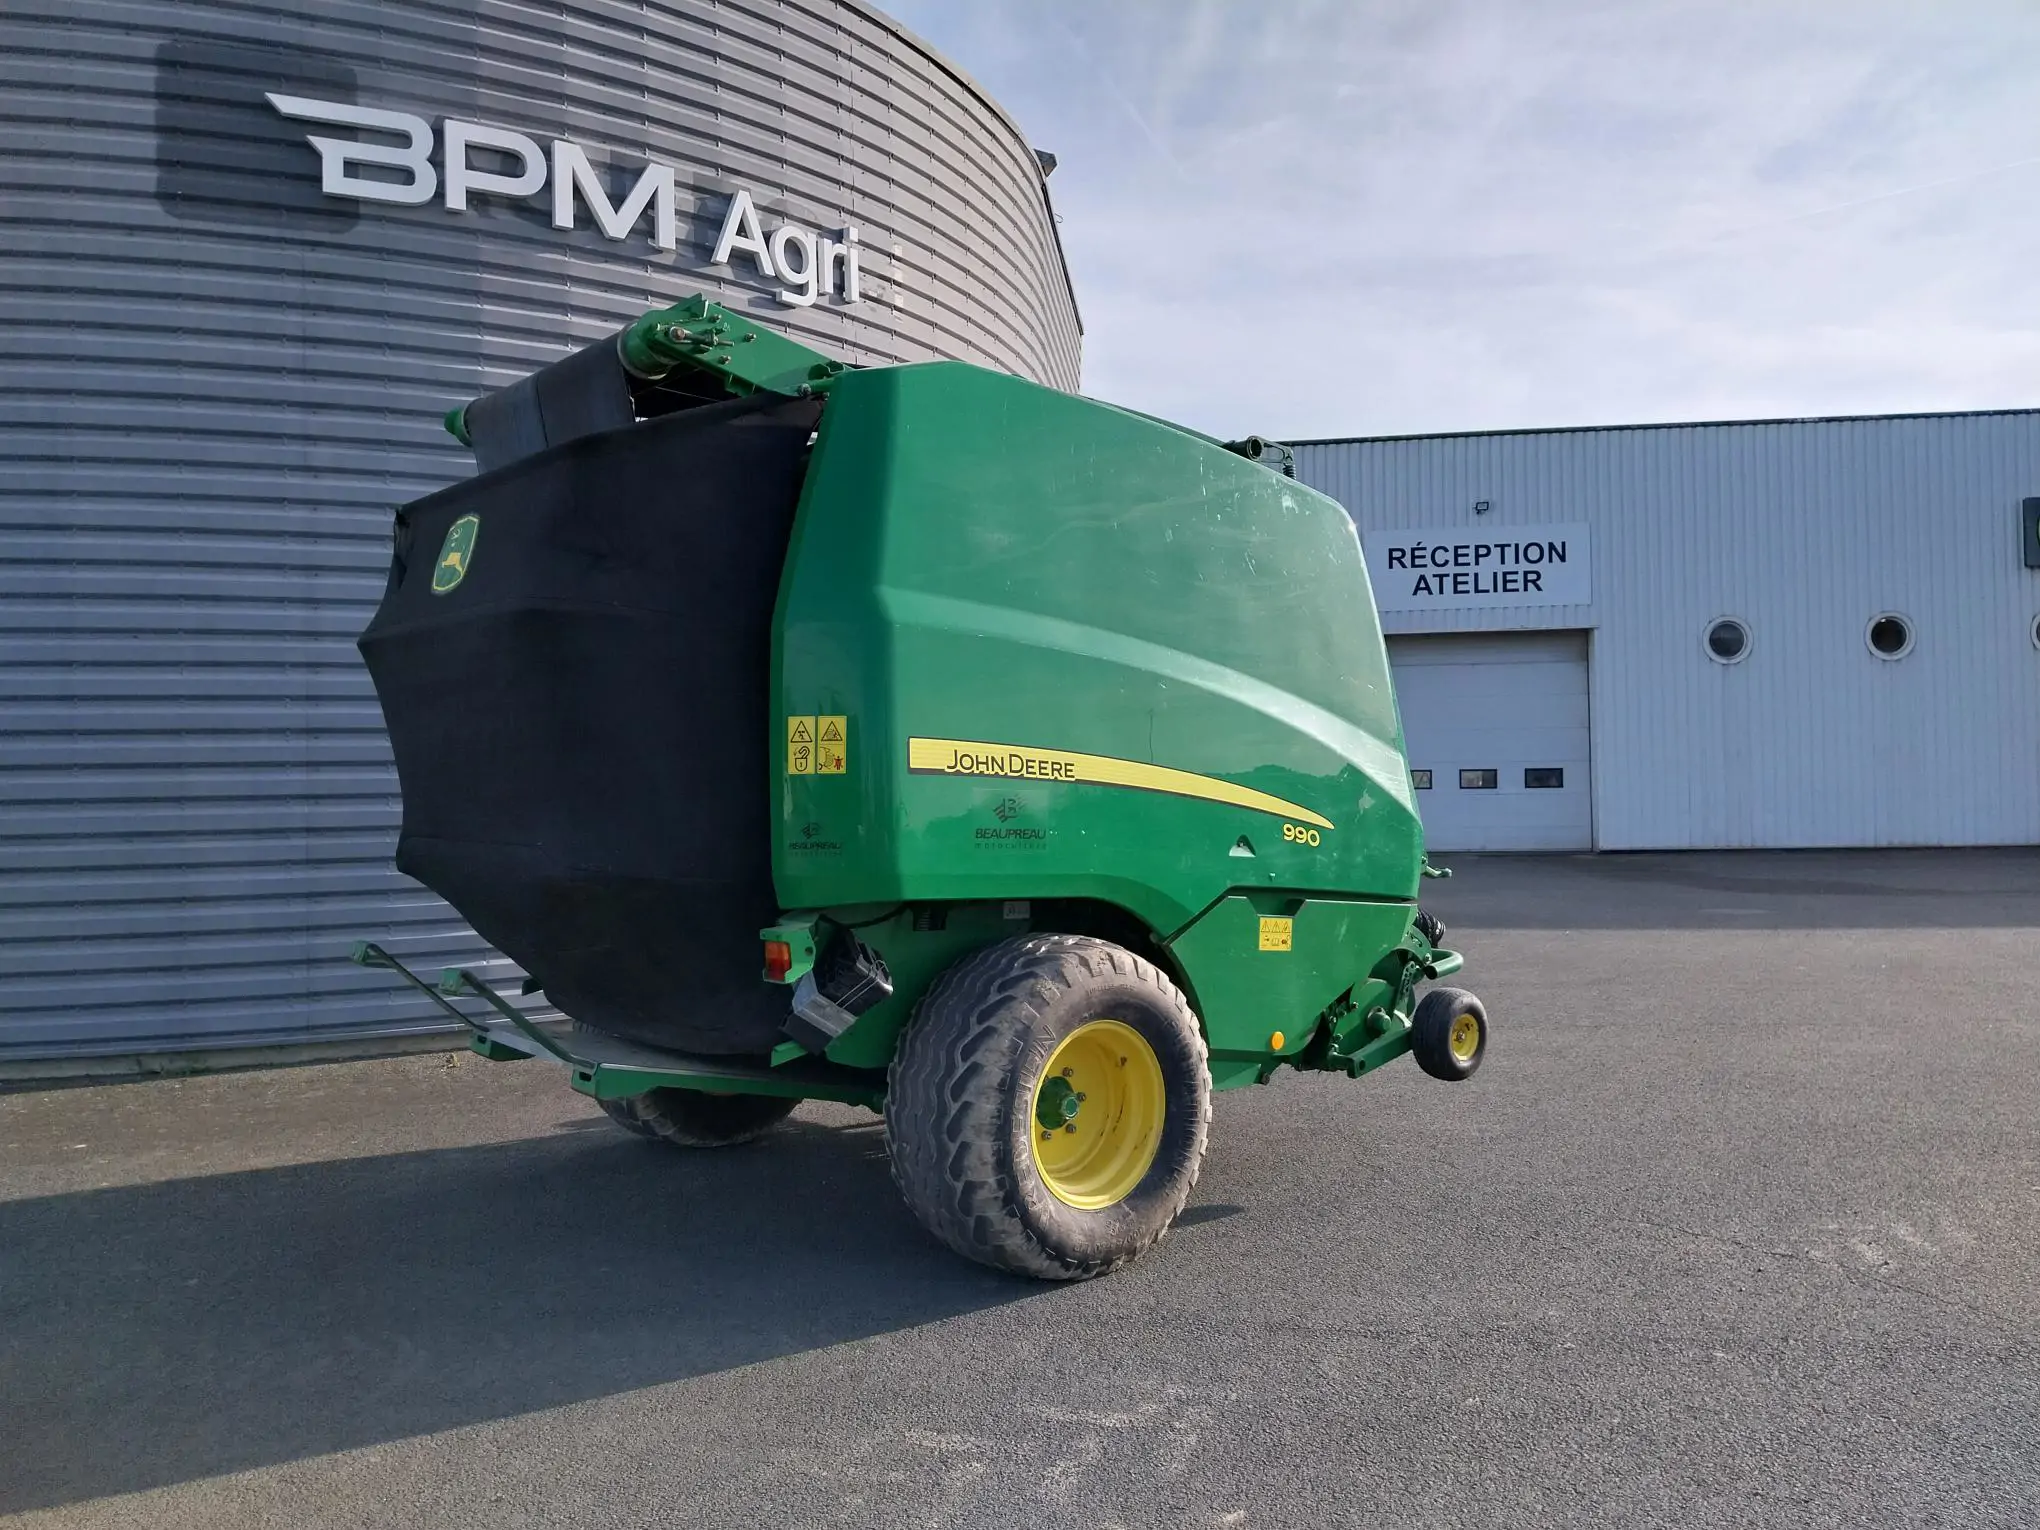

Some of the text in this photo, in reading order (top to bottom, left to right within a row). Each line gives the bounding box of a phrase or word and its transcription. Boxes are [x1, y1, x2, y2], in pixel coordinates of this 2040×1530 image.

[265, 93, 860, 307] BPM Agri
[1388, 541, 1567, 569] RÉCEPTION
[1412, 569, 1543, 596] ATELIER
[947, 749, 1076, 778] JOHN DEERE
[975, 828, 1047, 840] BEAUPREAU
[1283, 823, 1321, 847] 990
